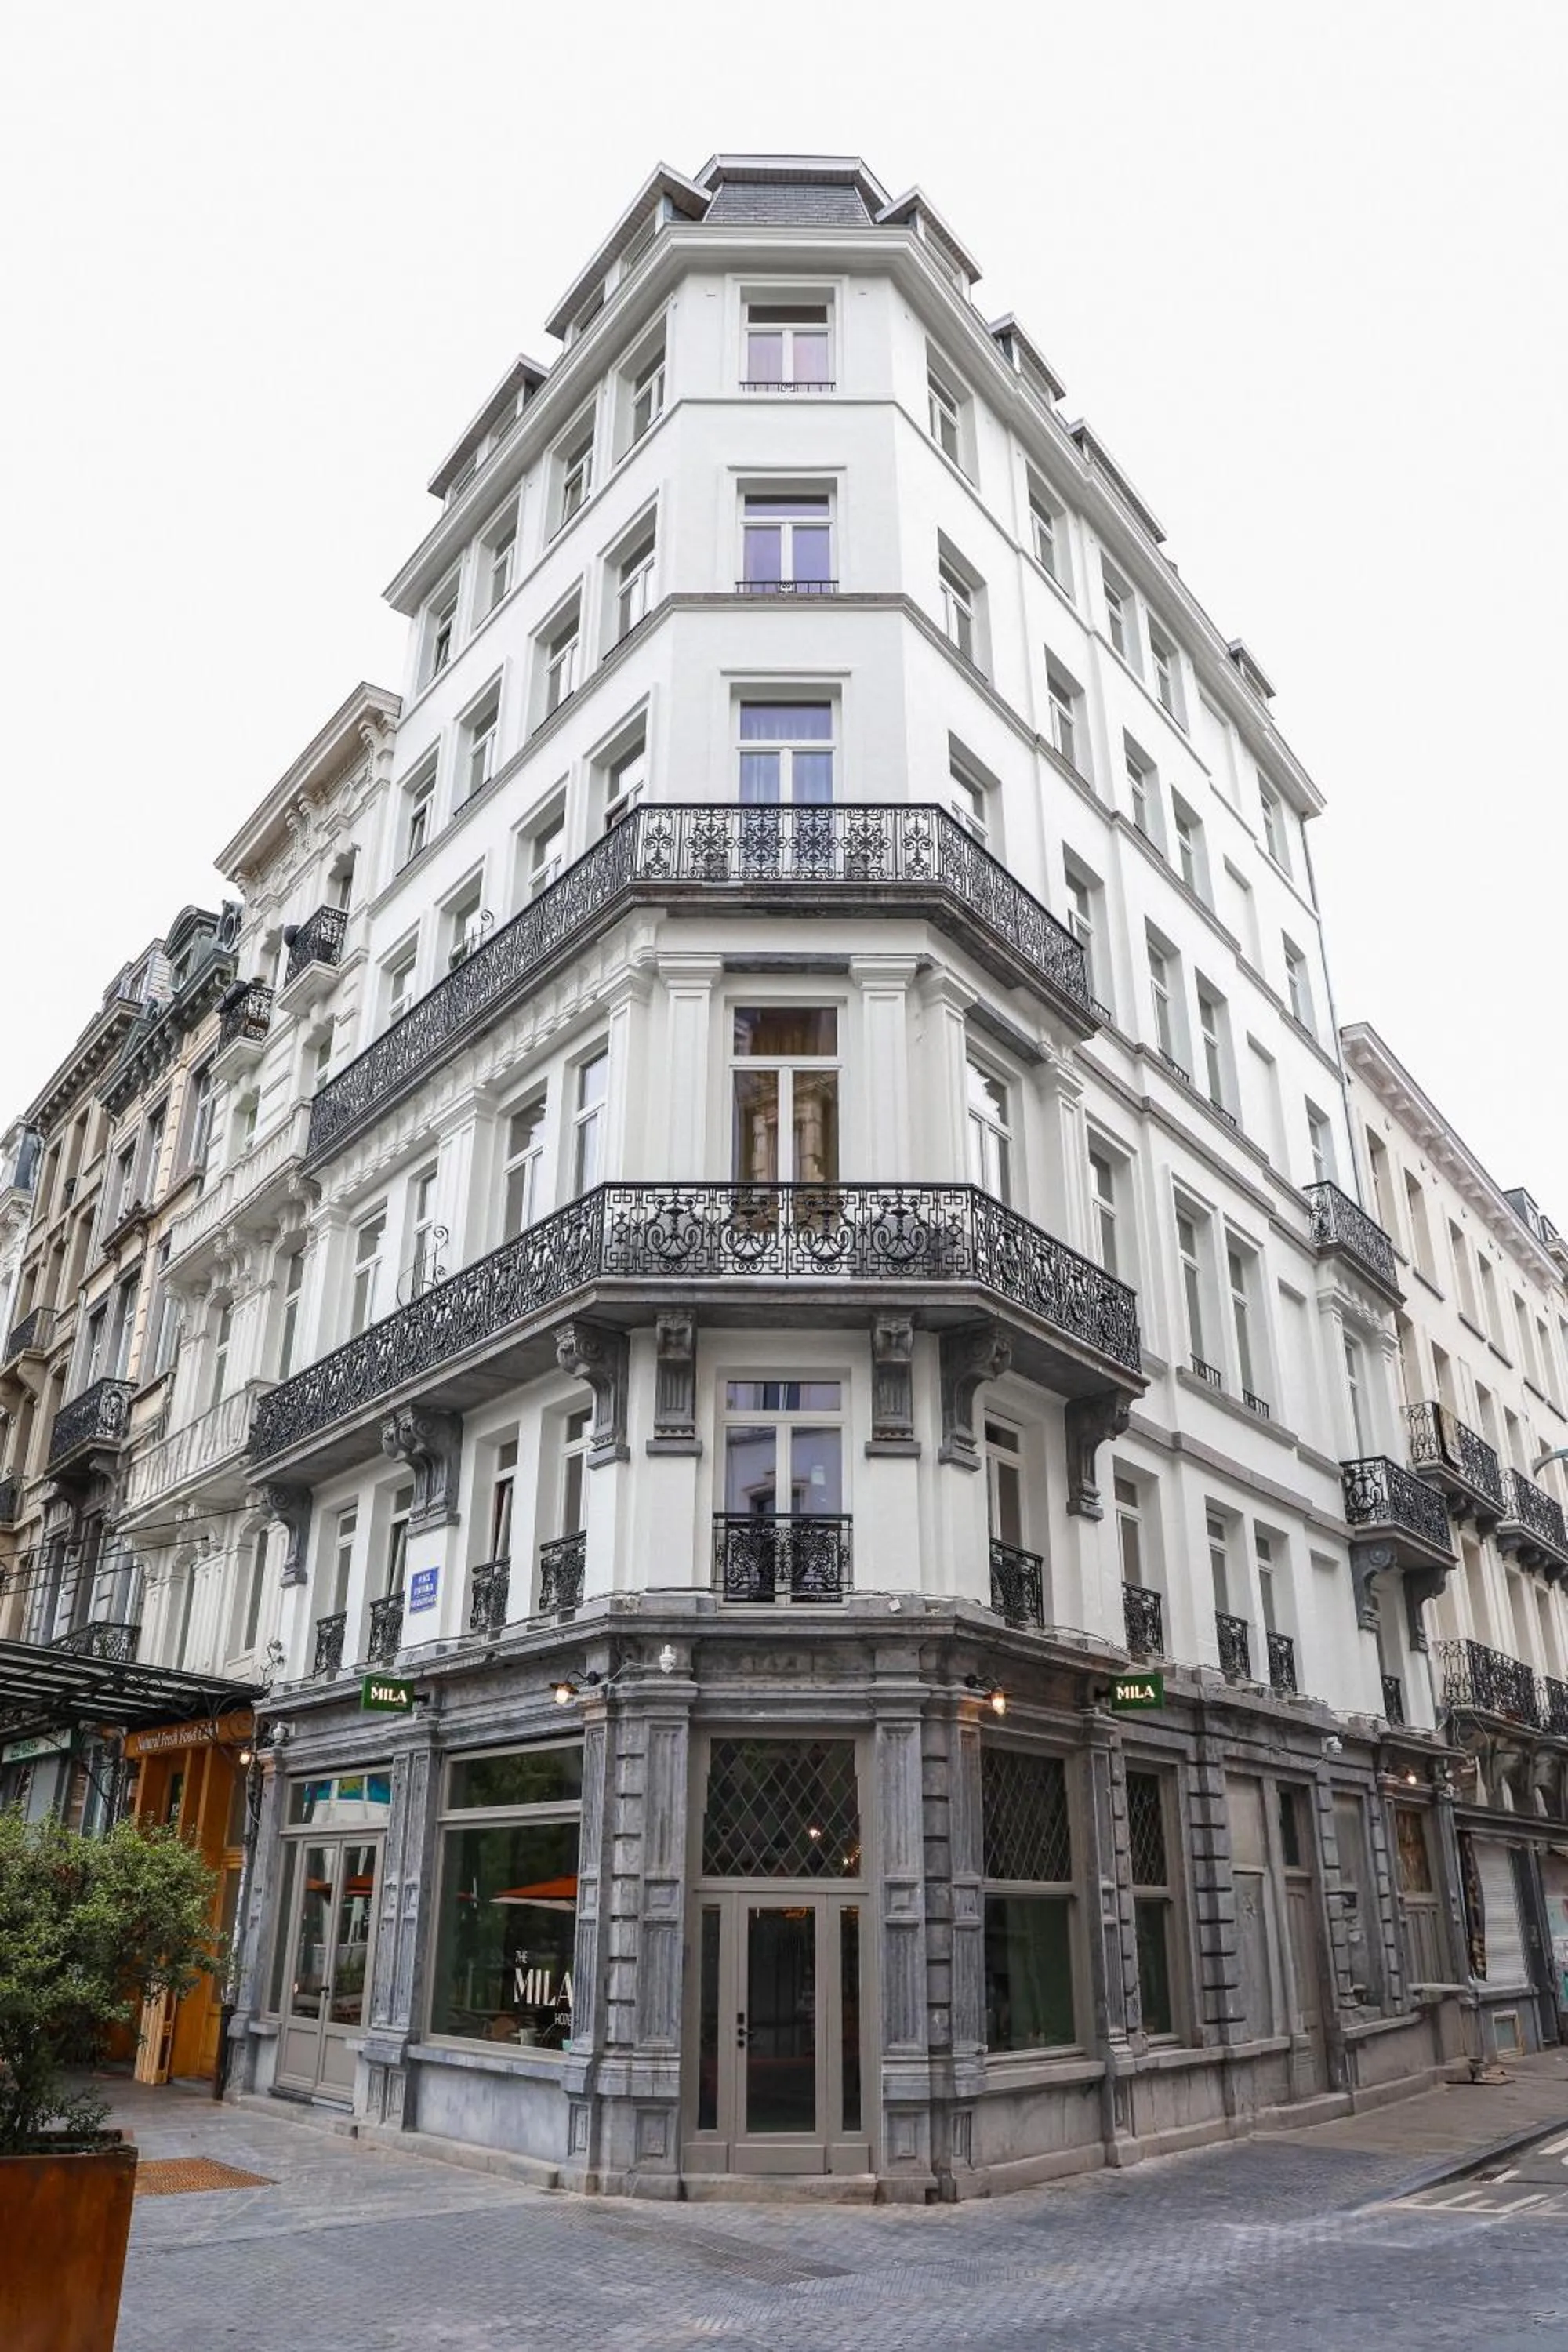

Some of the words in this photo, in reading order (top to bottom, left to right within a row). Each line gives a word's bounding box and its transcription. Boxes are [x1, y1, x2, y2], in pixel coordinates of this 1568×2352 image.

[371, 1686, 407, 1703] MILA
[1116, 1685, 1155, 1700] MILA
[514, 1966, 573, 2008] MILA
